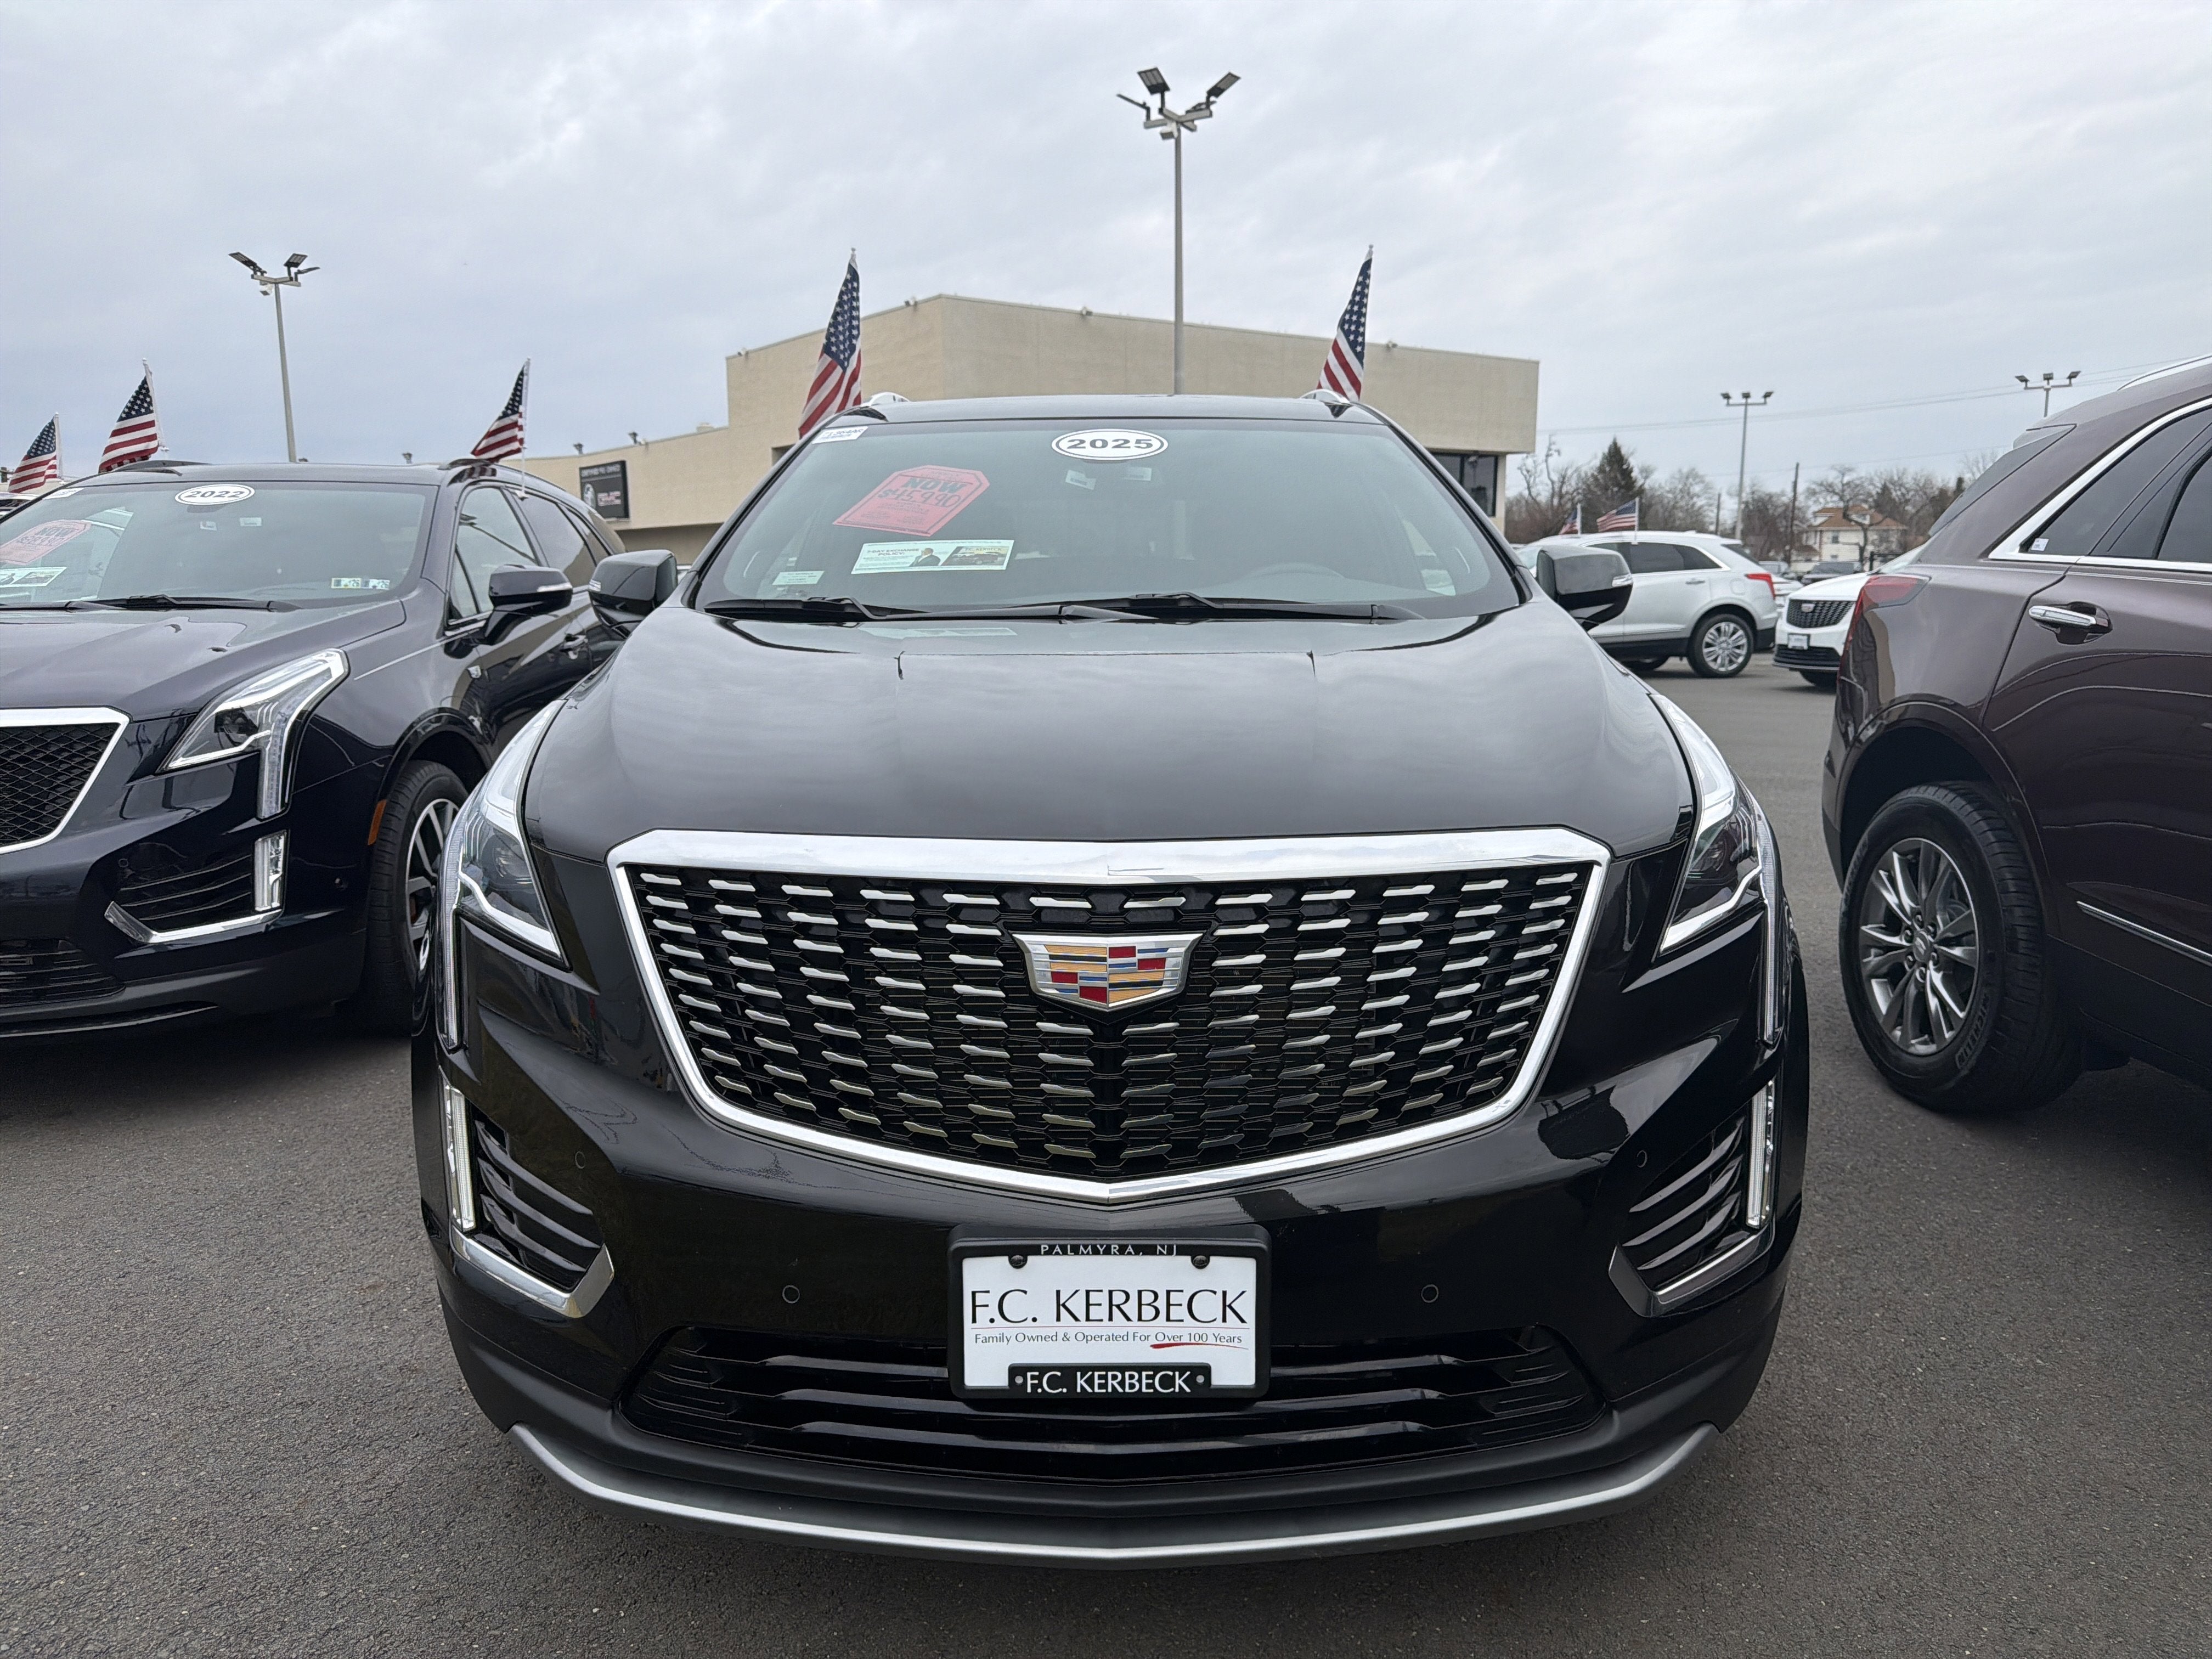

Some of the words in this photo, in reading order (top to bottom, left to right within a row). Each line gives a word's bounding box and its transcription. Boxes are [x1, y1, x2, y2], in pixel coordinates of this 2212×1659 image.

[1066, 438, 1153, 449] 2025
[901, 477, 967, 493] NOW
[1041, 1244, 1143, 1257] PALMYRA,
[1156, 1244, 1176, 1256] NJ
[970, 1289, 1038, 1324] F.C.
[1055, 1289, 1248, 1324] KERBECK
[975, 1332, 1012, 1345] Family
[1015, 1331, 1058, 1342] Owned
[1062, 1331, 1070, 1342] &
[1075, 1331, 1129, 1344] Operated
[1132, 1331, 1151, 1342] For
[1155, 1331, 1183, 1342] Over
[1188, 1332, 1209, 1342] 100
[1212, 1333, 1243, 1343] Years
[1026, 1371, 1068, 1393] F.C.
[1076, 1371, 1191, 1393] KERBECK
